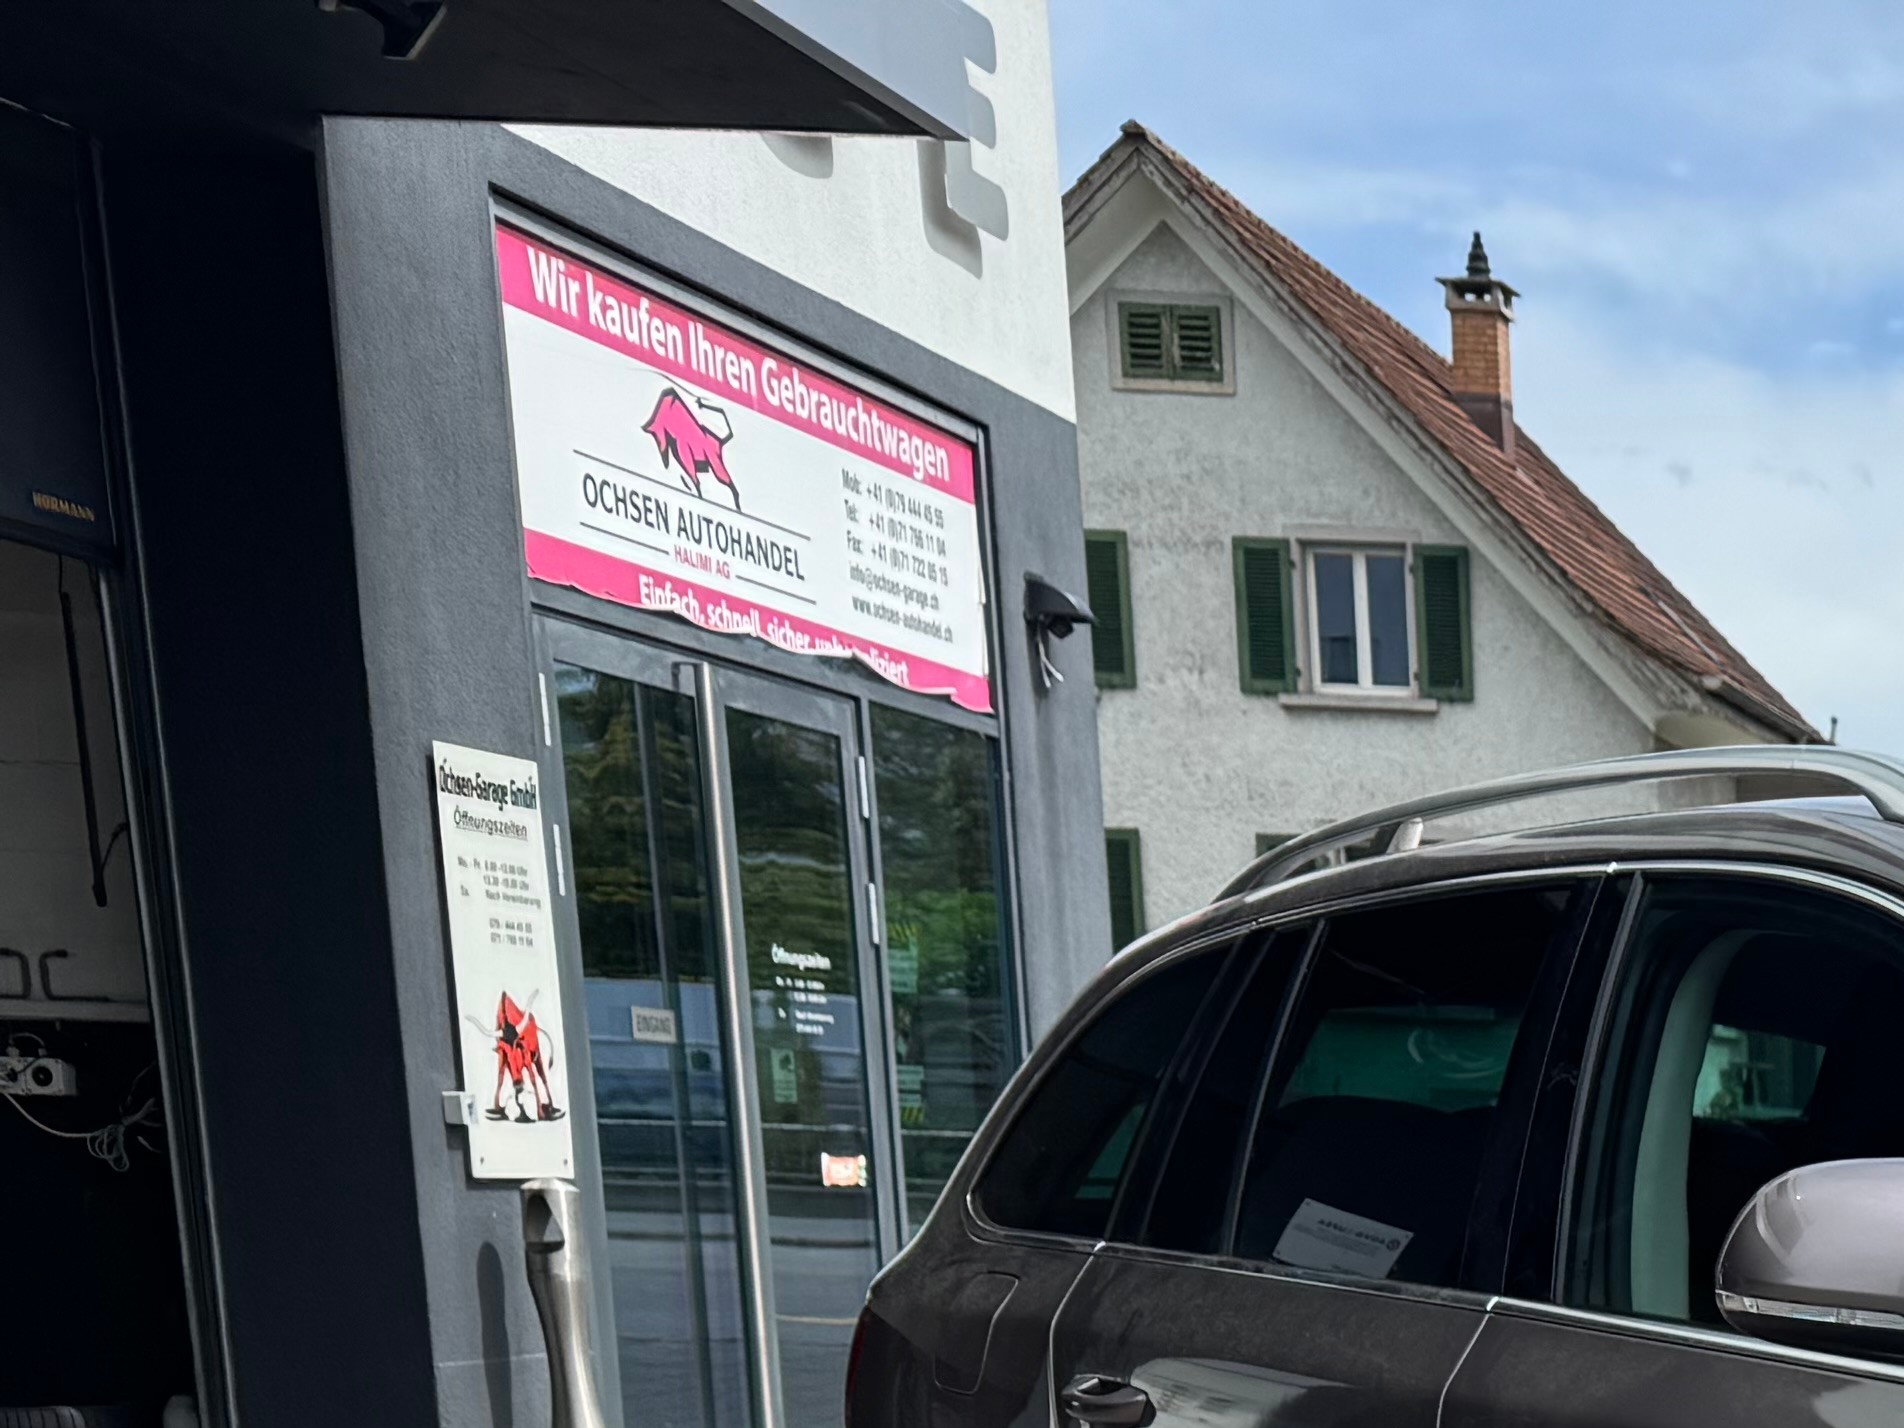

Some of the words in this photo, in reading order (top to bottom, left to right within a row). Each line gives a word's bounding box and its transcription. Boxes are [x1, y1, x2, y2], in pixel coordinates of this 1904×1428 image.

[527, 246, 581, 318] Wir
[587, 270, 684, 364] kaufen
[689, 322, 757, 402] Ihren
[761, 360, 950, 482] Gebrauchtwagen
[582, 473, 671, 535] OCHSEN
[677, 506, 805, 581] AUTOHANDEL
[674, 544, 712, 573] HALIMI
[714, 559, 731, 580] AG
[636, 1014, 672, 1035] EINGANG
